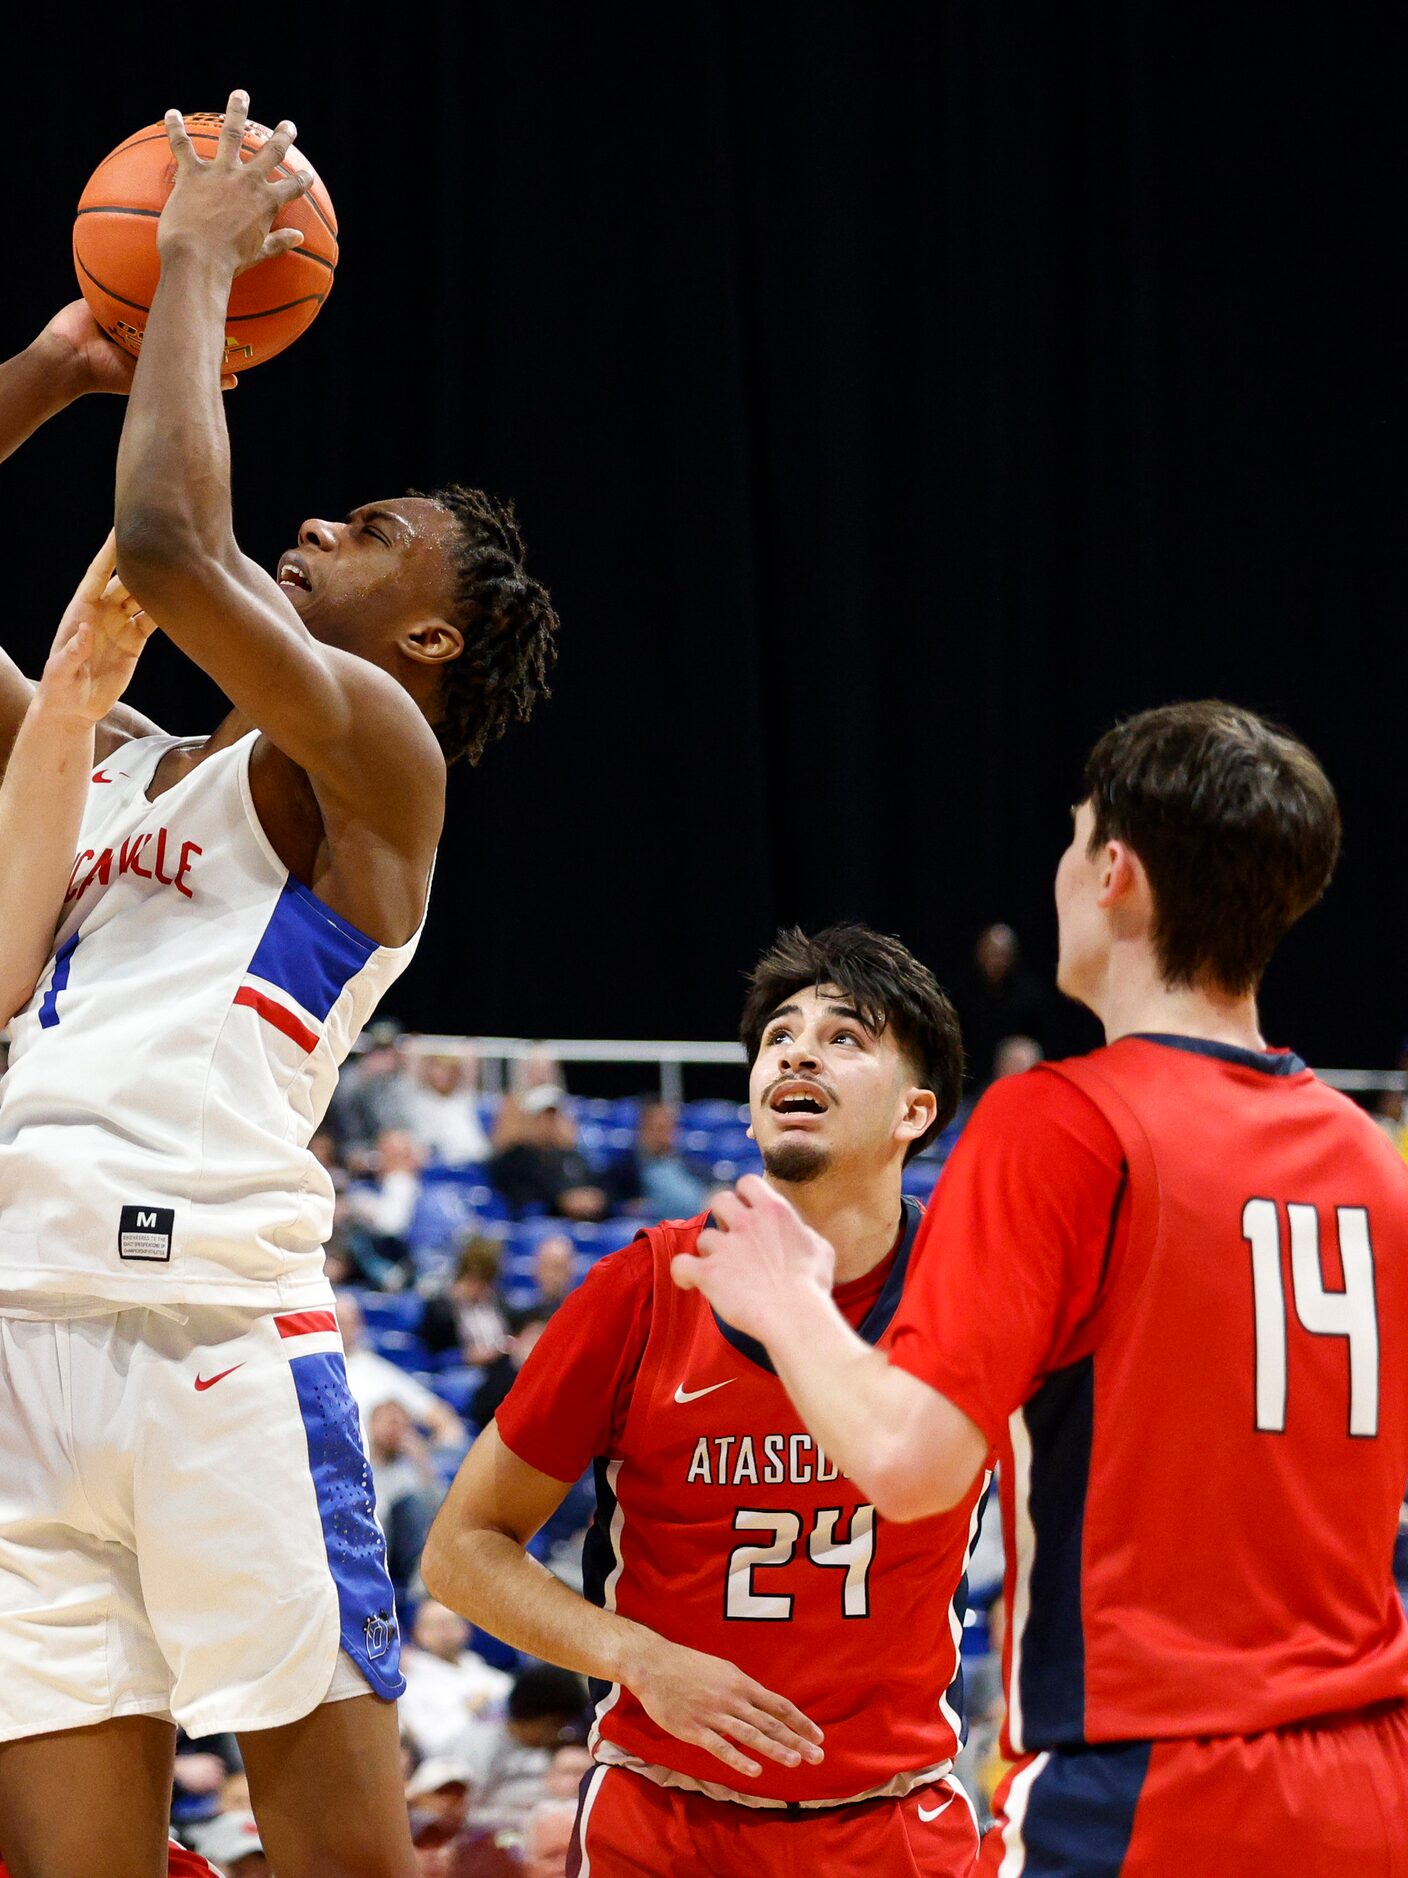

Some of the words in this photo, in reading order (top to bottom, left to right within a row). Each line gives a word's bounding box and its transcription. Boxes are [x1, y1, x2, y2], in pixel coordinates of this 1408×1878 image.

[136, 1211, 157, 1228] M
[1241, 1196, 1379, 1438] 14
[686, 1433, 850, 1486] ATASCO
[723, 1503, 877, 1621] 24
